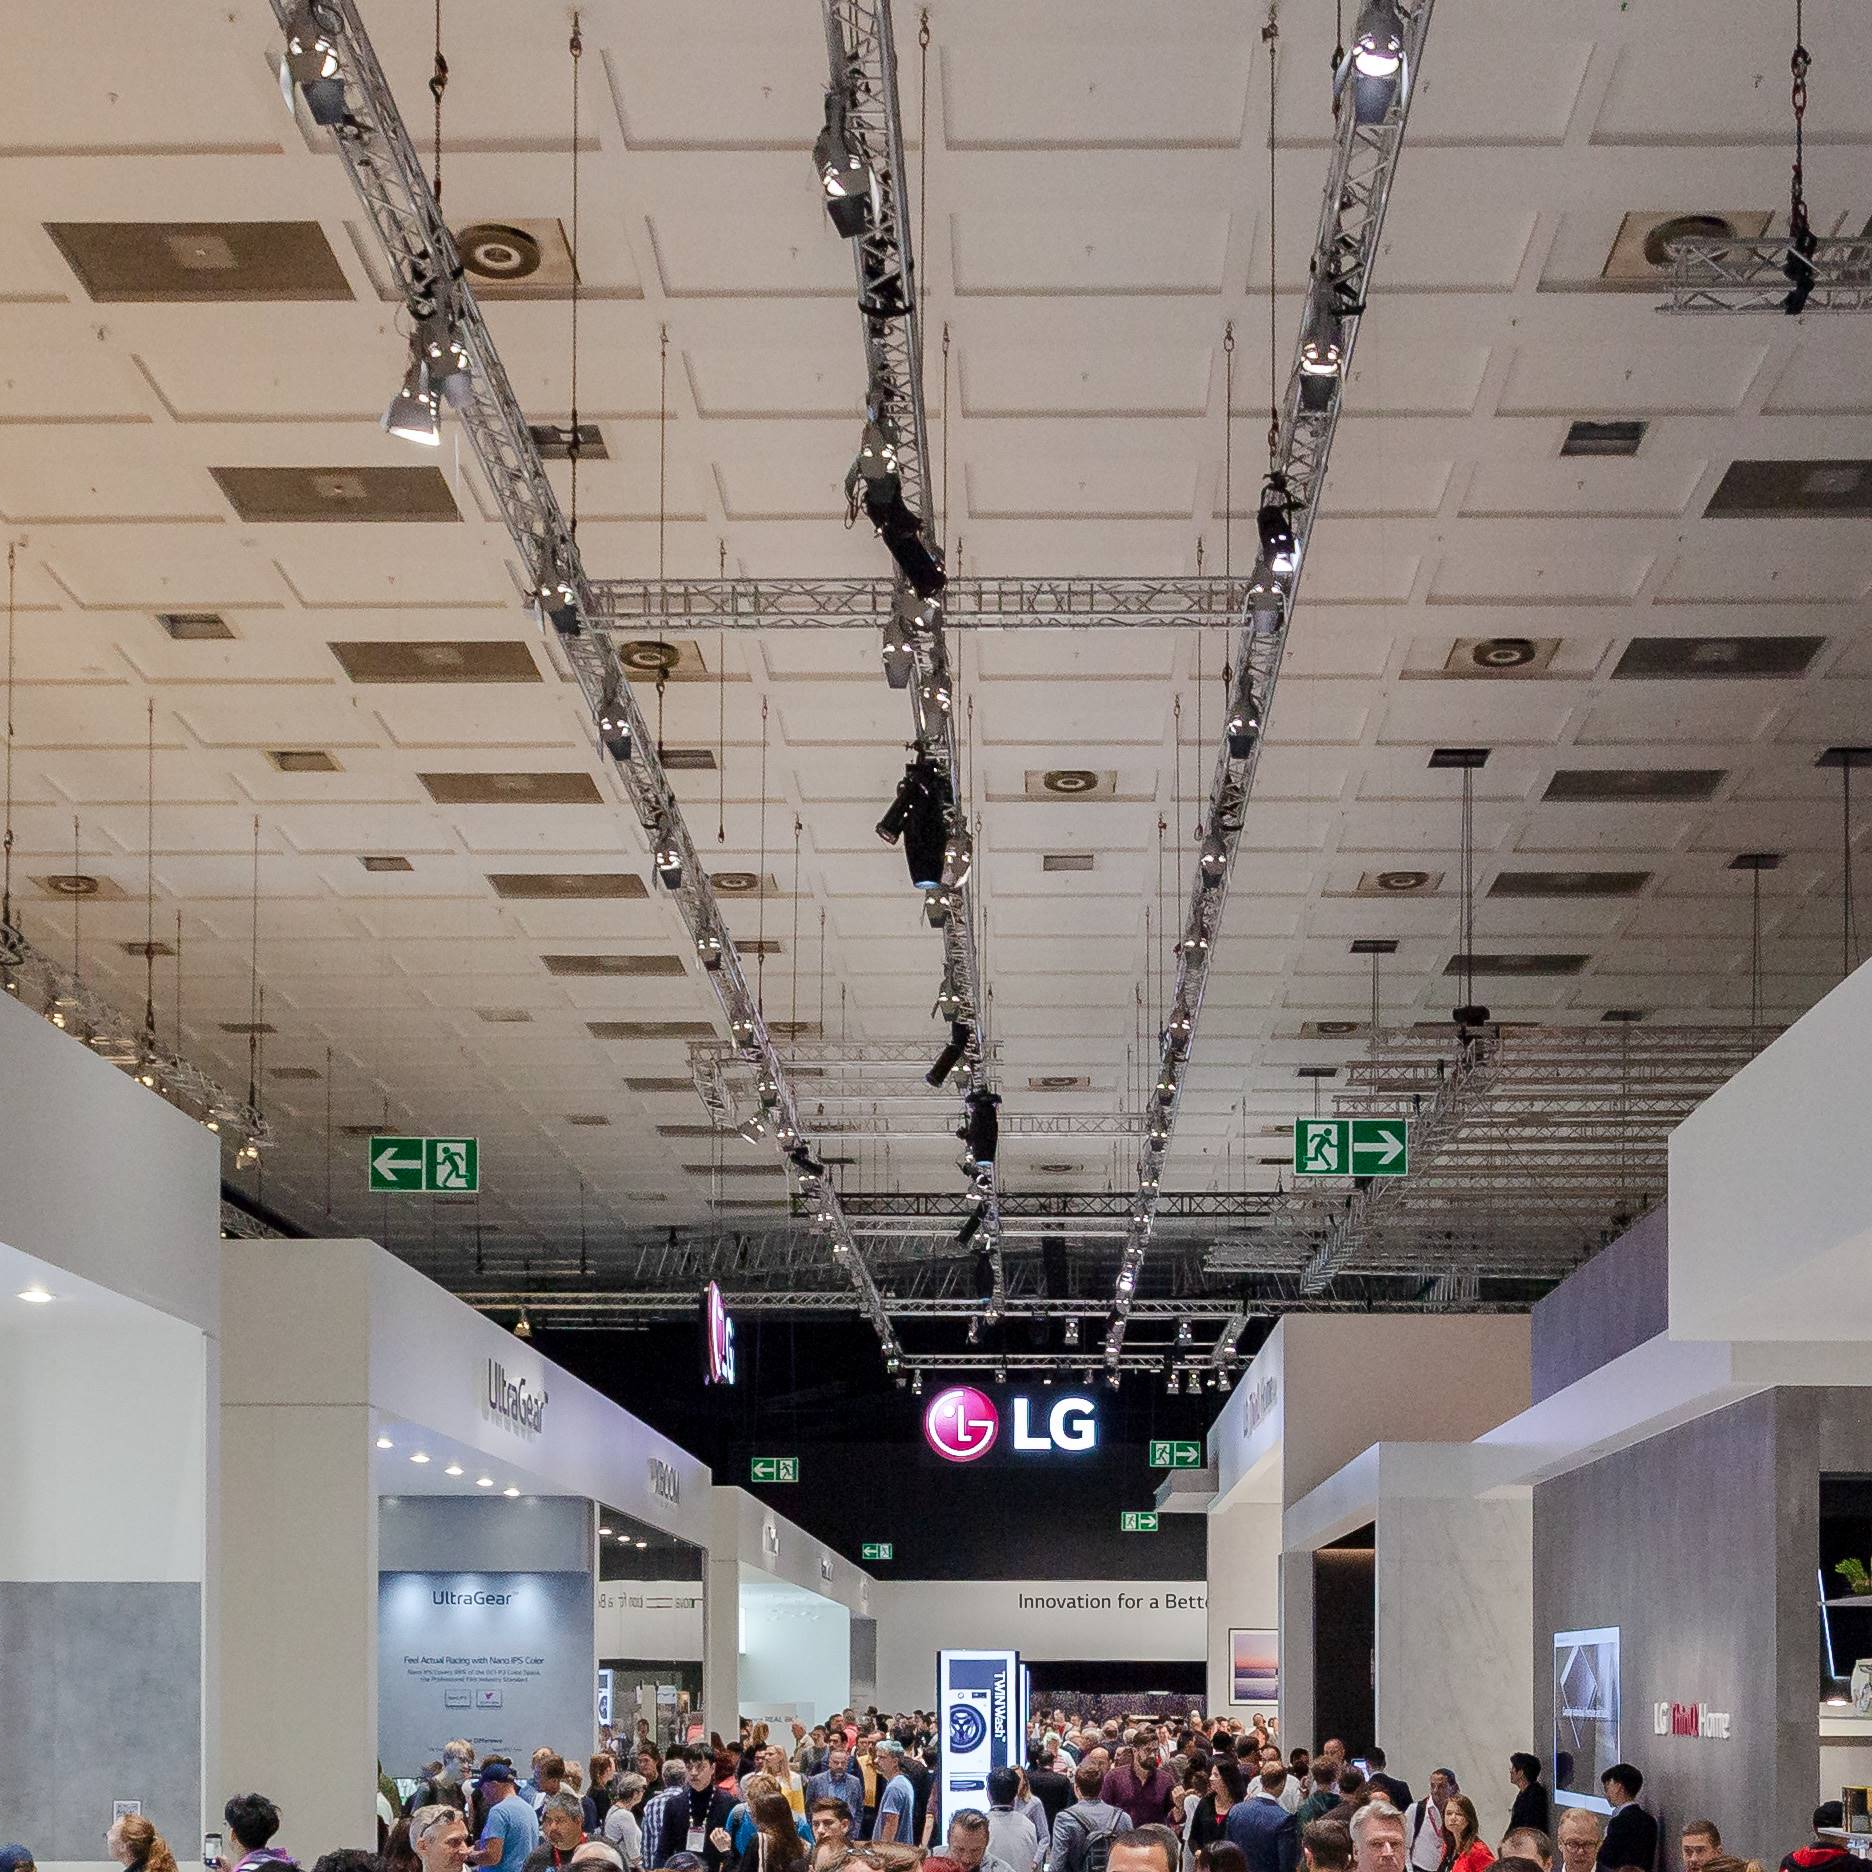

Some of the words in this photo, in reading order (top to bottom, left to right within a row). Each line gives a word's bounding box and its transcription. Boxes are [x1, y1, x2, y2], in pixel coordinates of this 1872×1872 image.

[1012, 1396, 1097, 1451] LG
[1017, 1592, 1112, 1610] Innovation
[1117, 1592, 1144, 1610] for
[1149, 1597, 1160, 1610] a
[420, 1656, 445, 1666] Actual
[445, 1656, 470, 1667] Racing
[471, 1656, 488, 1666] with
[489, 1656, 510, 1666] Nano
[524, 1656, 545, 1666] Color
[1653, 1701, 1669, 1736] LG
[1699, 1702, 1730, 1740] Home
